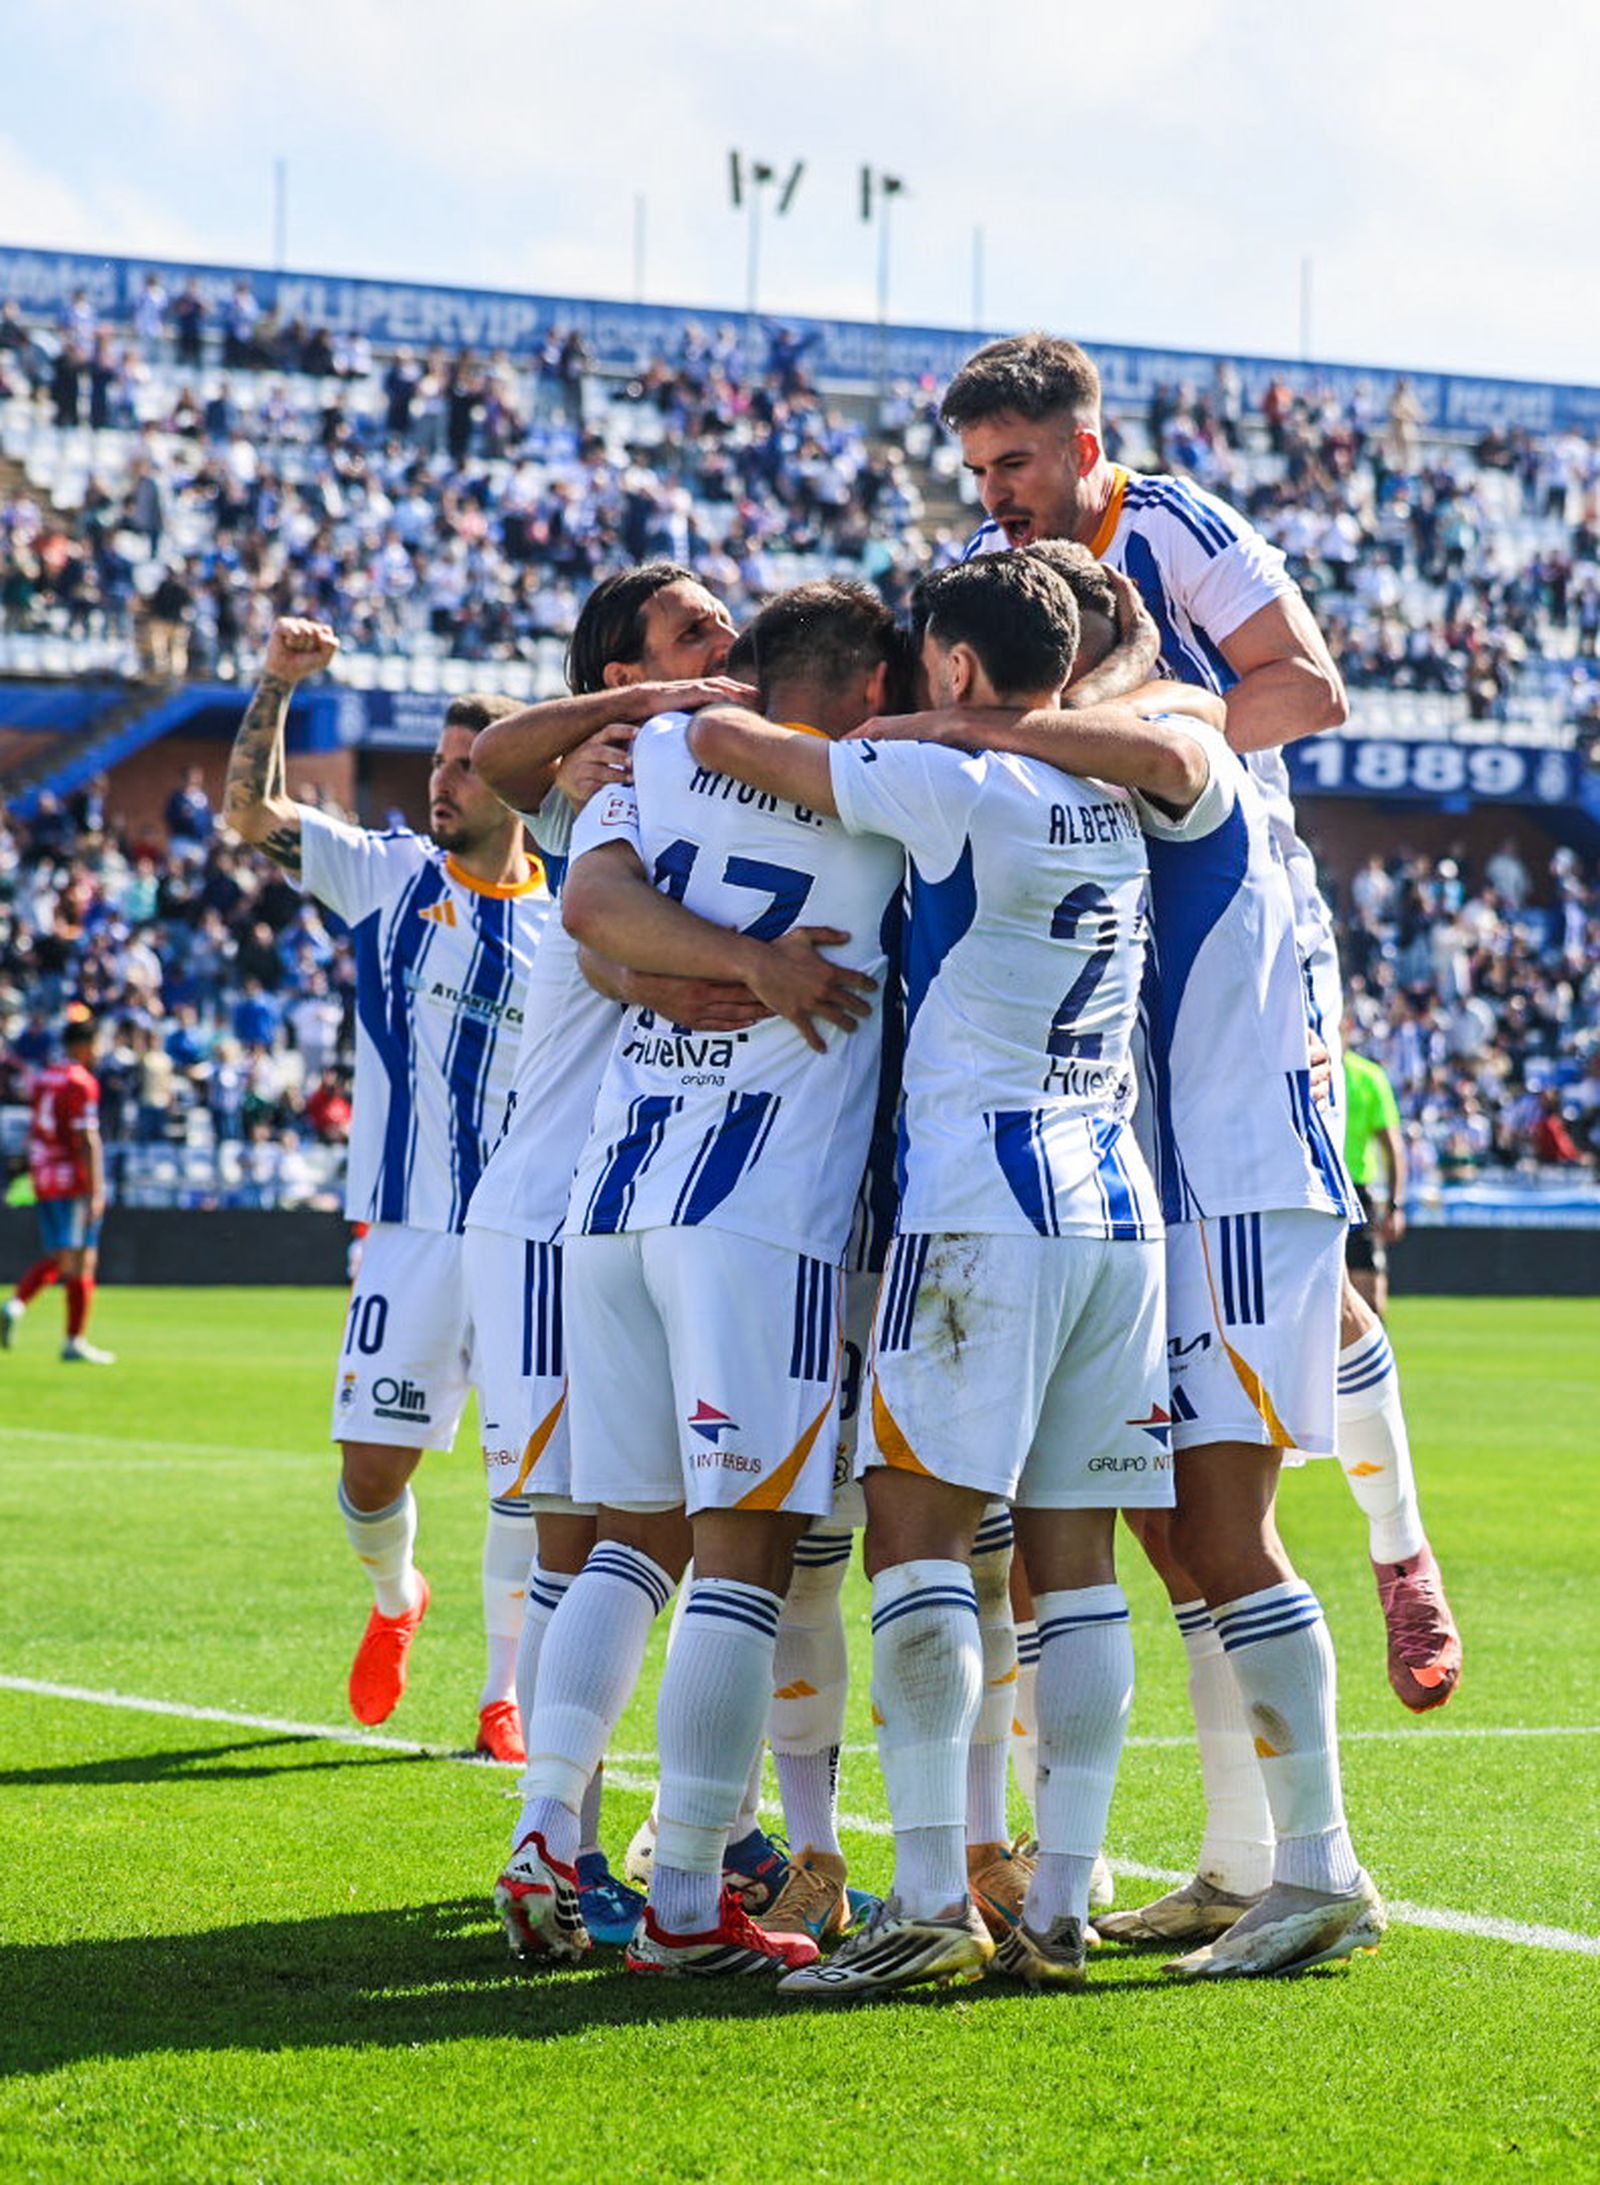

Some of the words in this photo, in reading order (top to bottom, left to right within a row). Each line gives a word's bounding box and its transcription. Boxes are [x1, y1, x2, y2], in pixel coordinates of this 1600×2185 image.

[1301, 740, 1525, 795] 1889
[1046, 882, 1117, 1060] 2
[345, 1294, 389, 1355] 10
[372, 1377, 426, 1411] Olin
[1088, 1456, 1147, 1472] GRUPO
